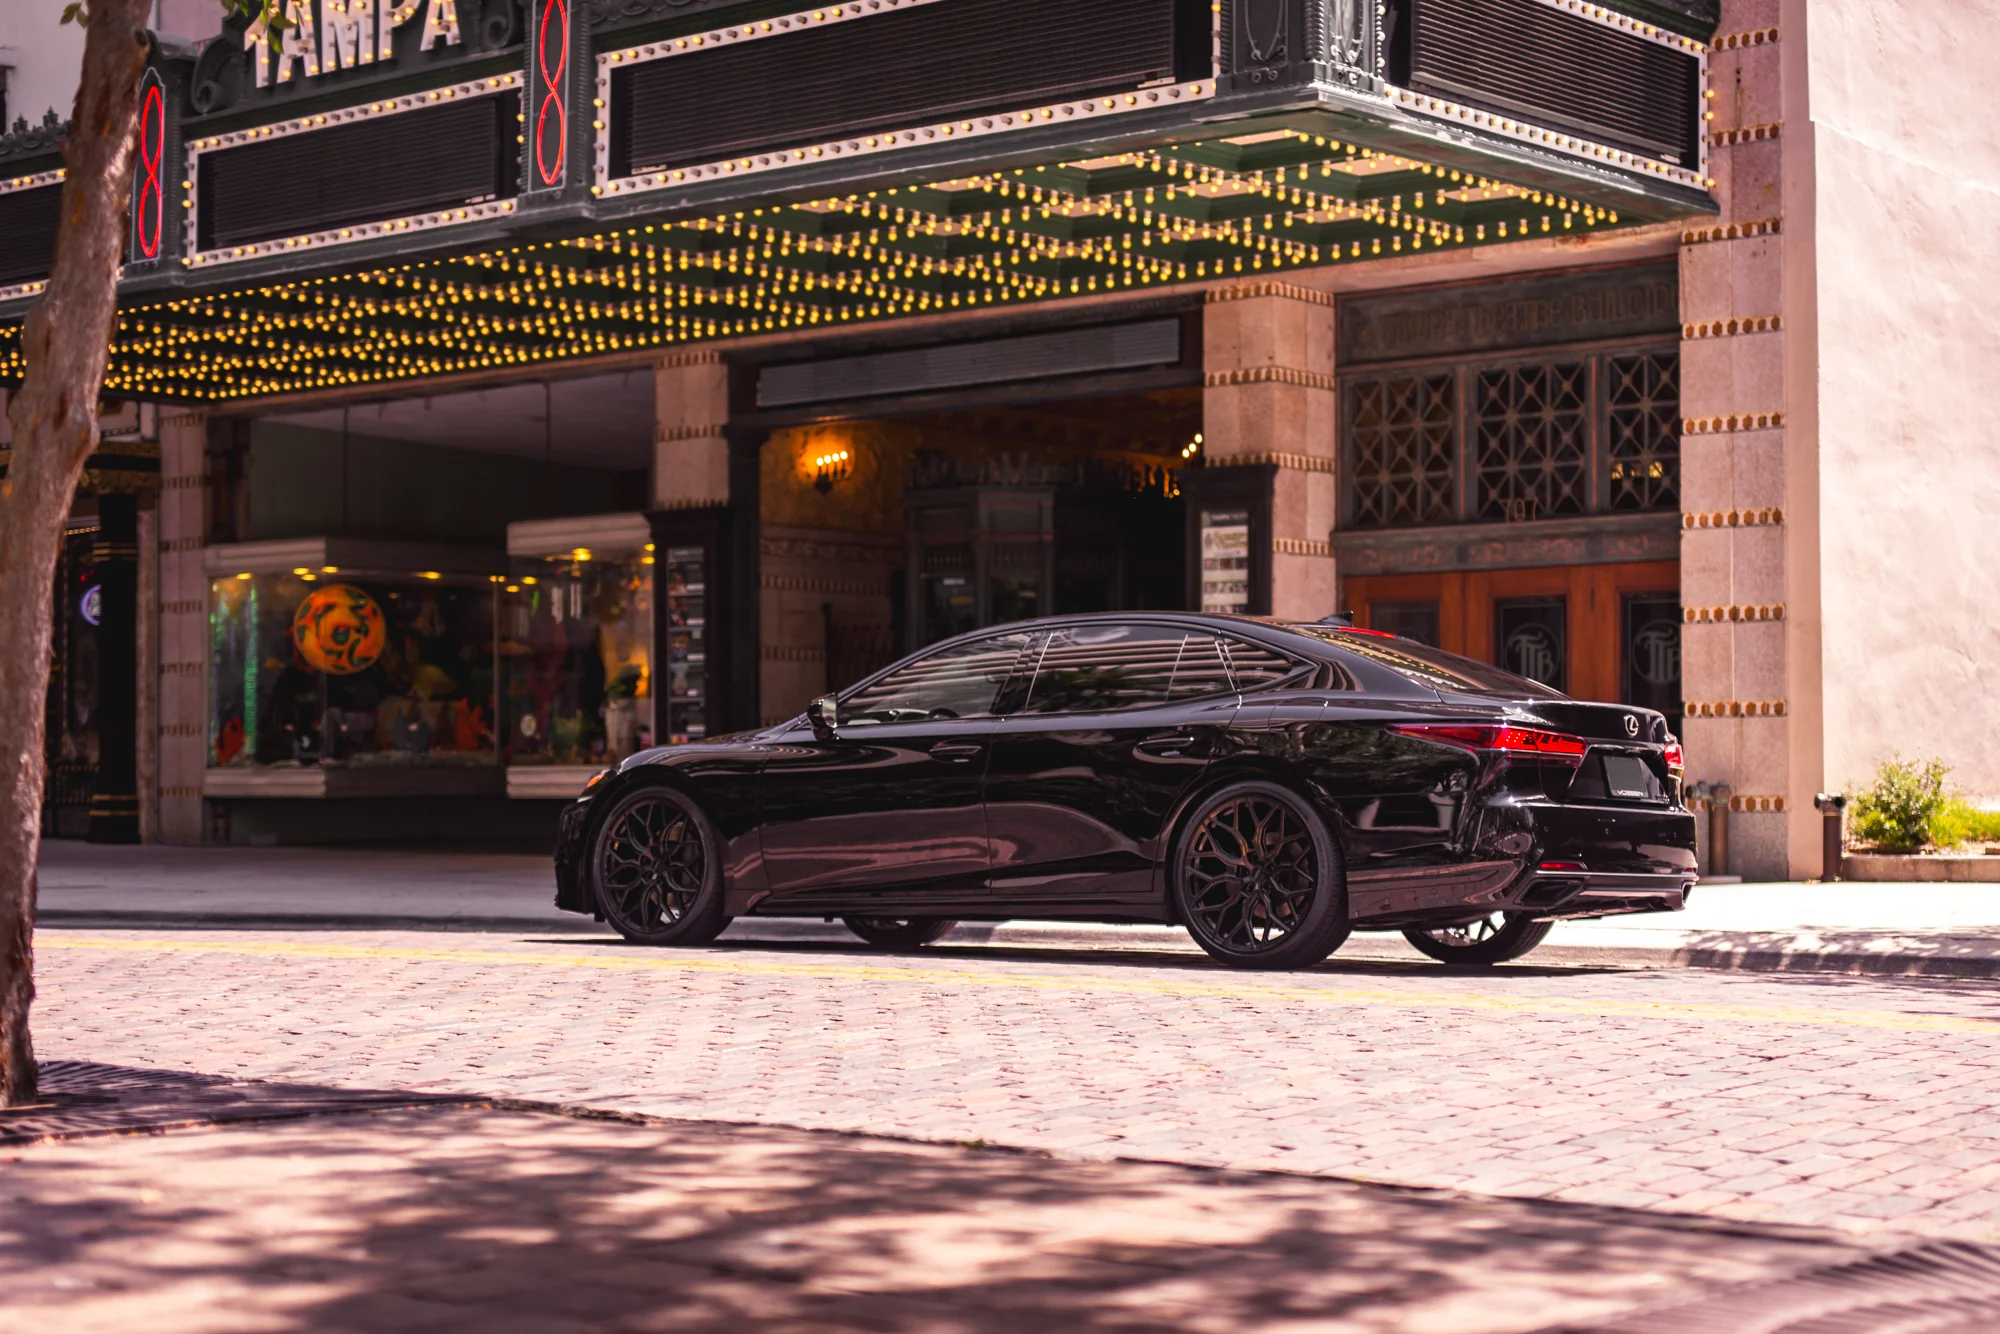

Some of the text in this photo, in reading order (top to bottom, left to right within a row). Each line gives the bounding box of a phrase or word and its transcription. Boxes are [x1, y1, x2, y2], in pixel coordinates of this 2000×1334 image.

[244, 0, 461, 88] TAMPA
[1500, 497, 1538, 523] 707
[1616, 789, 1644, 797] VOSSEN
